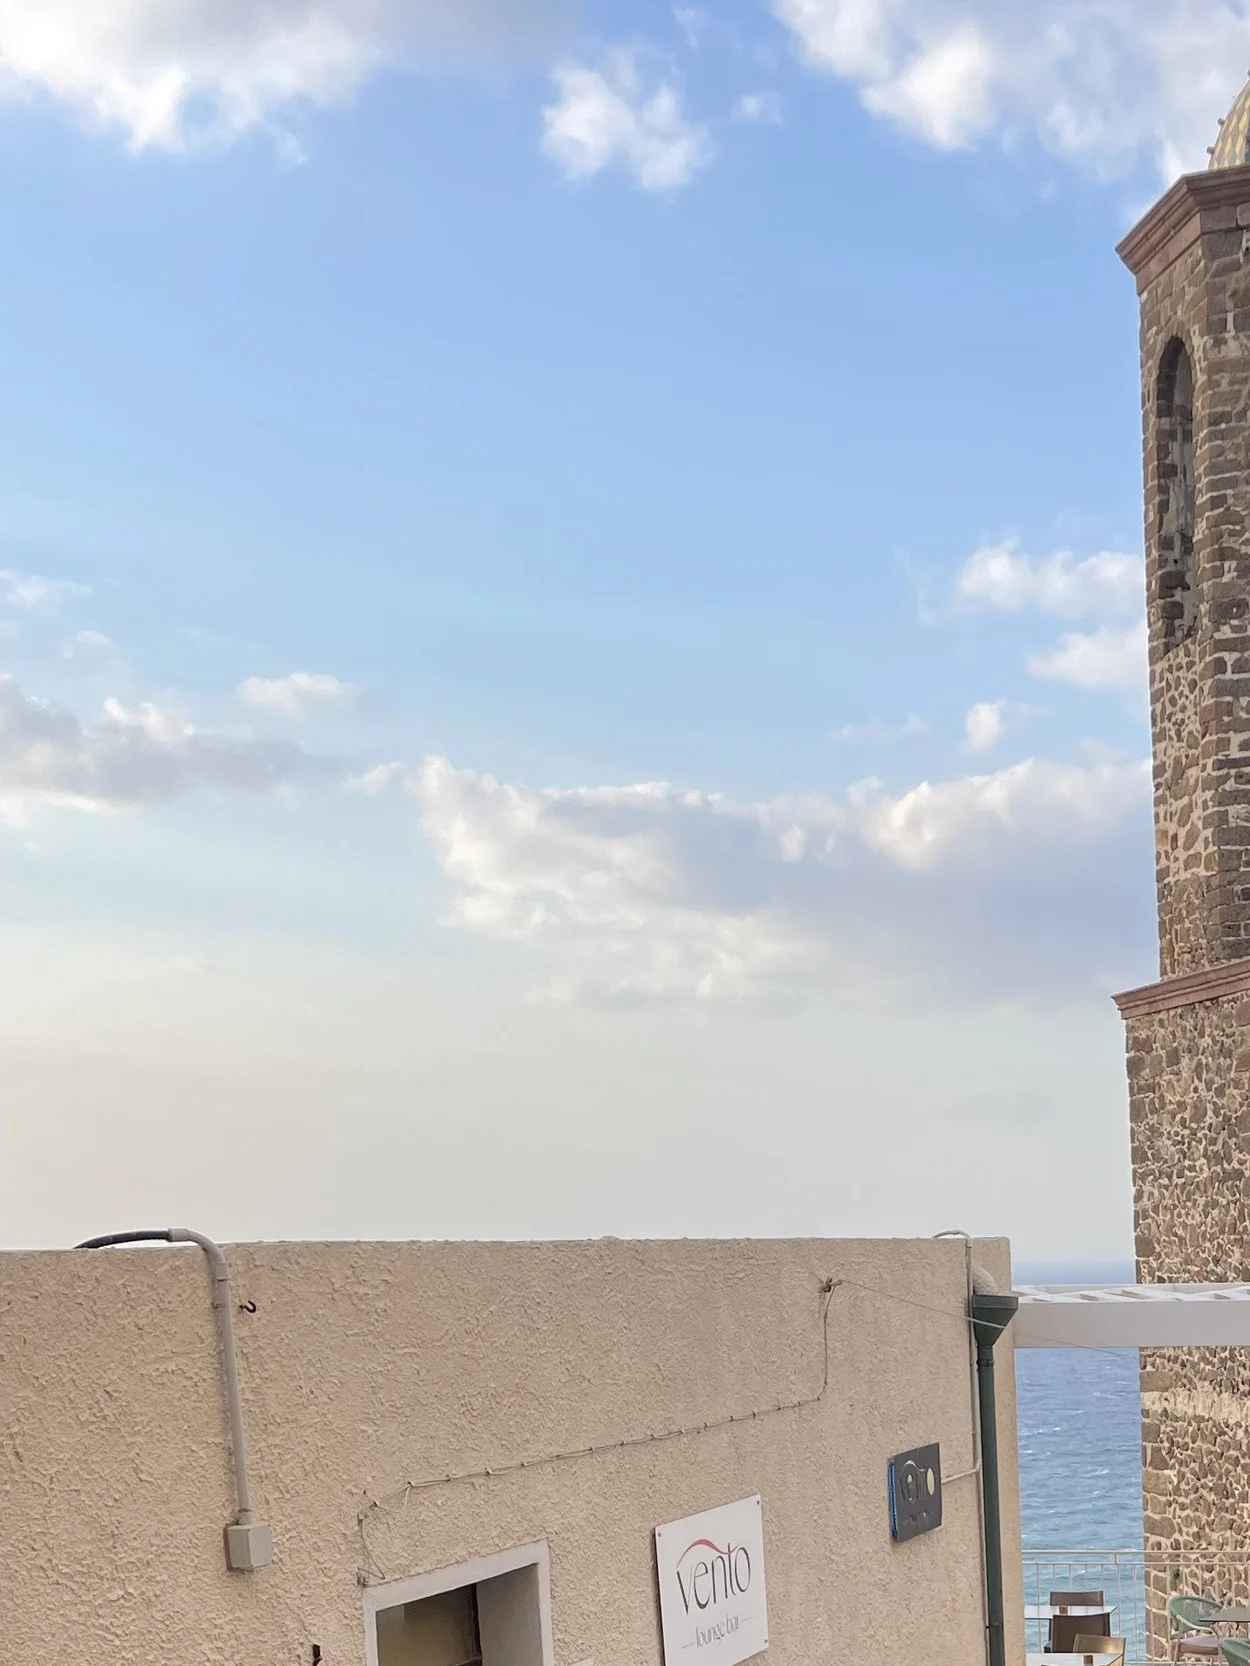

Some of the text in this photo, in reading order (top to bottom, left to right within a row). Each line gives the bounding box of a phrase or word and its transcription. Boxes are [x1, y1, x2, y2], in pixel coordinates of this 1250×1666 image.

[676, 1542, 750, 1615] vento
[696, 1614, 741, 1648] lounge bar
